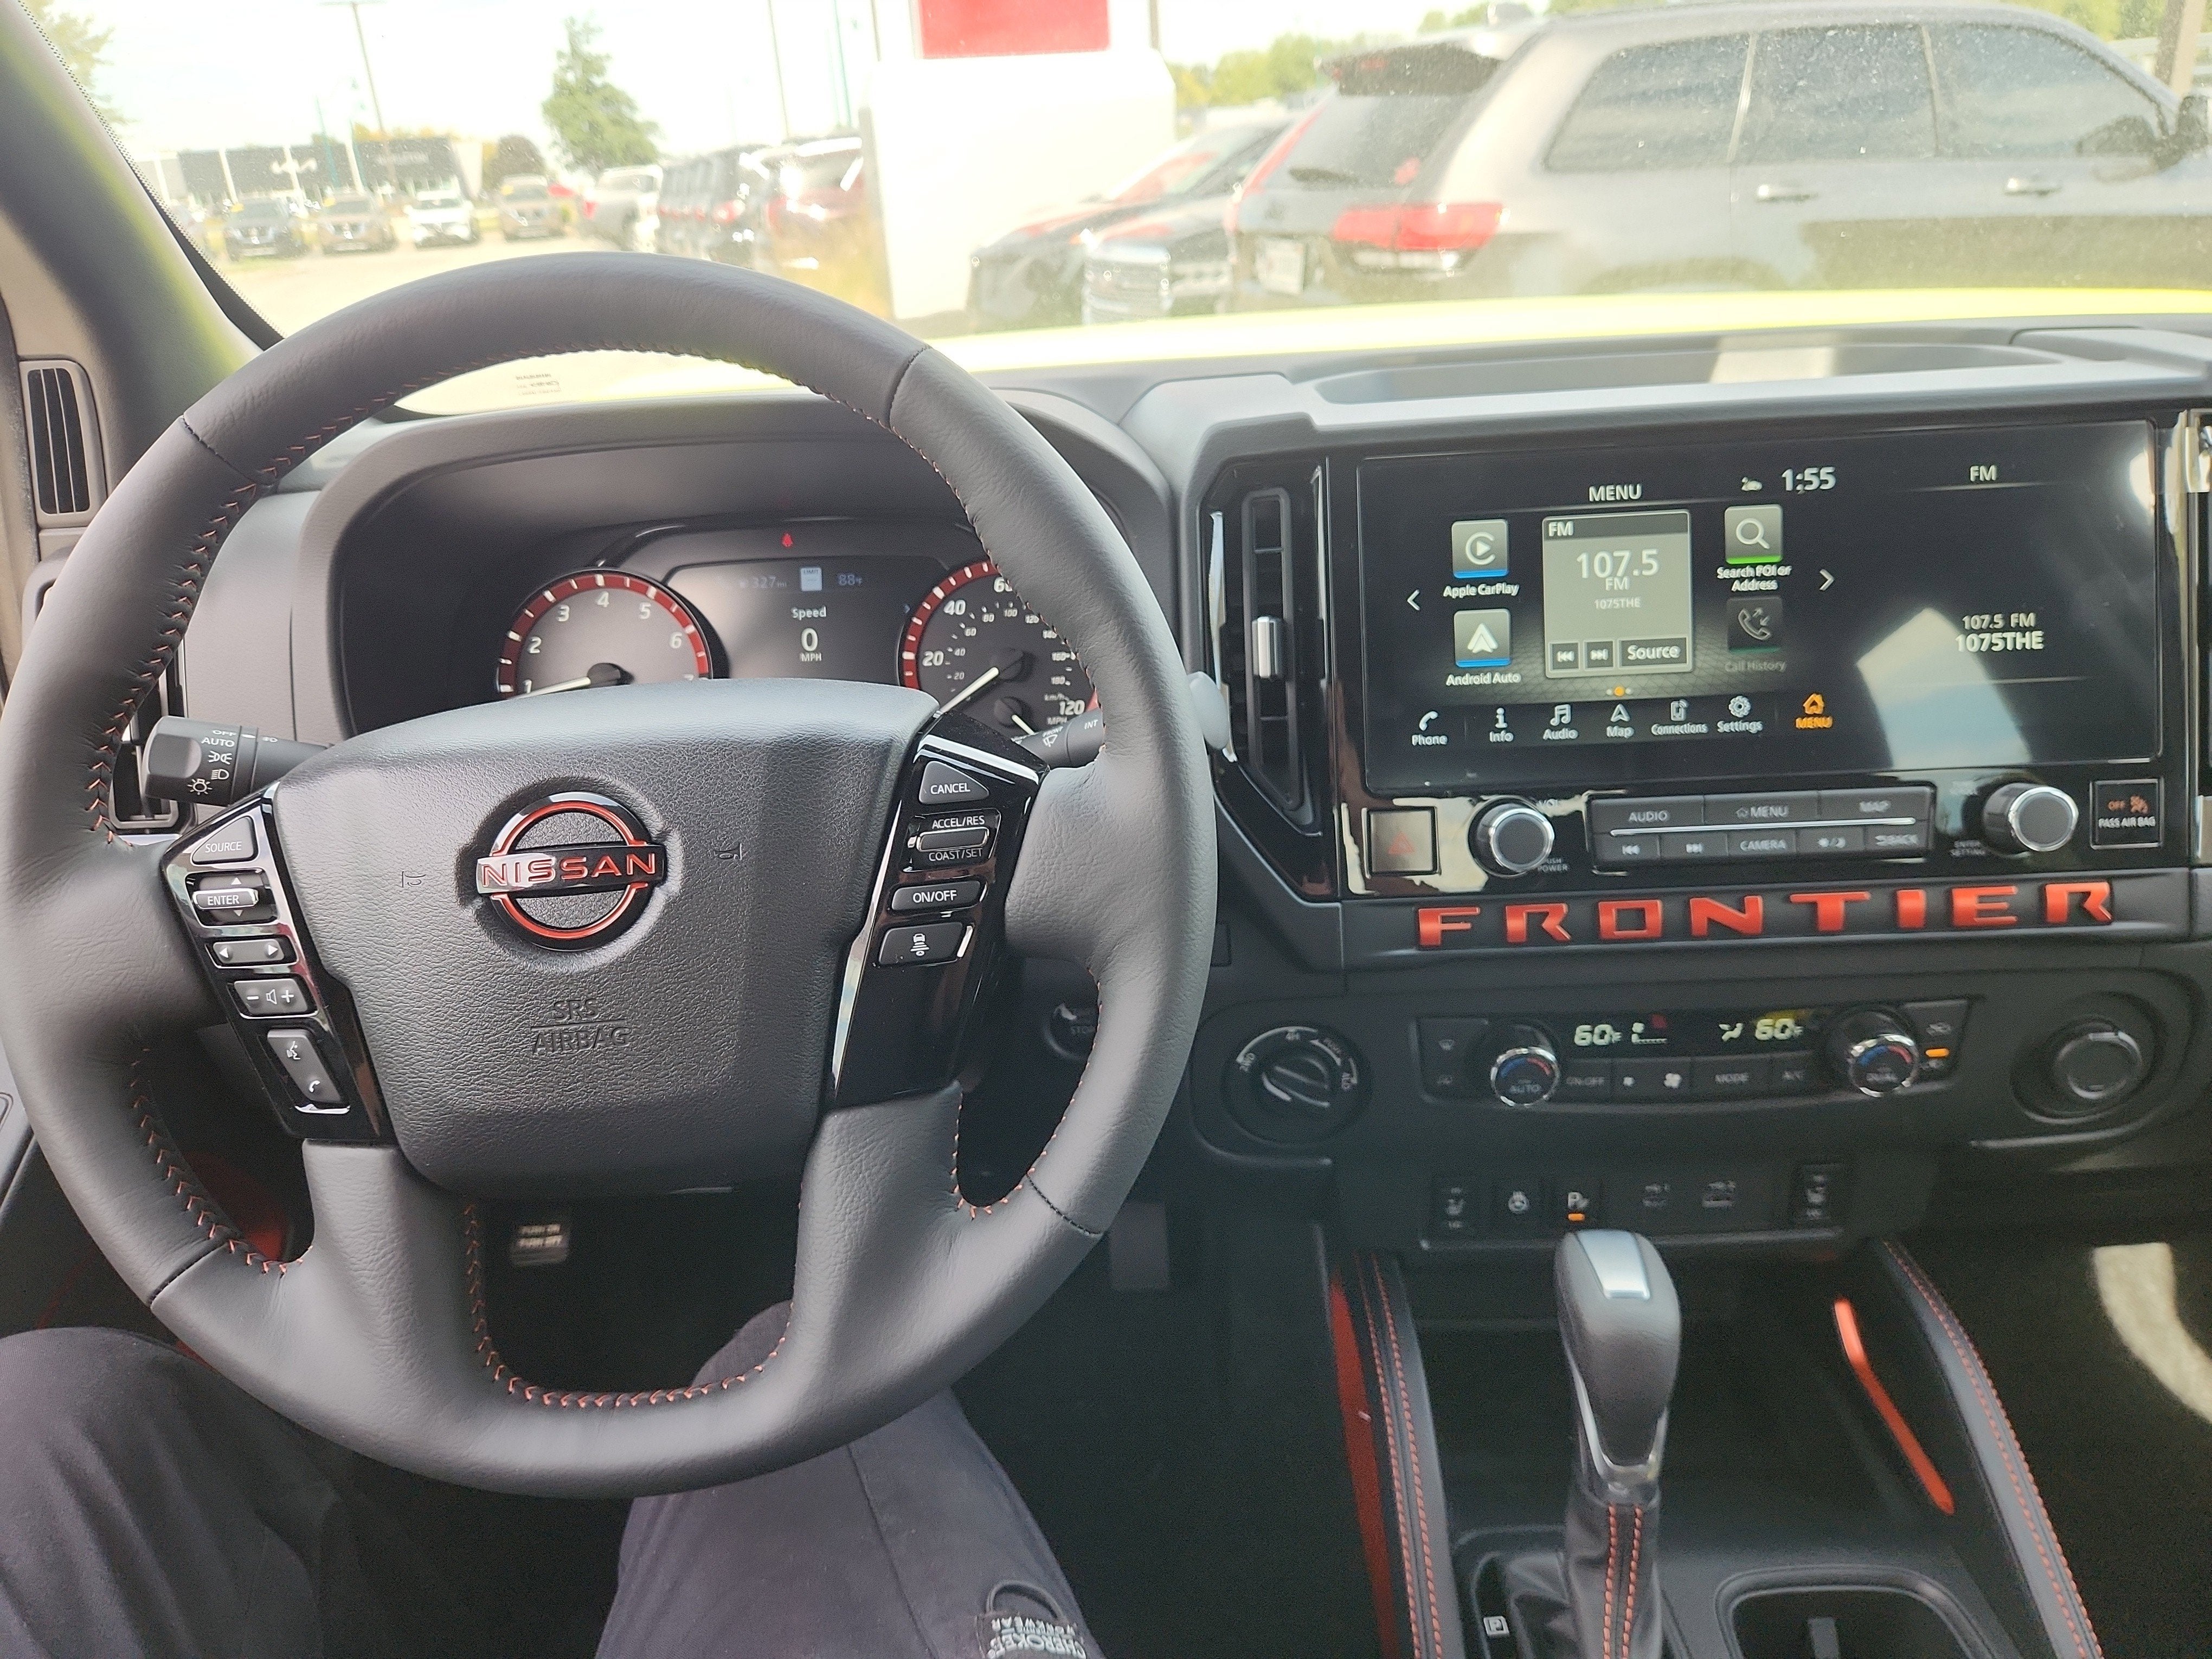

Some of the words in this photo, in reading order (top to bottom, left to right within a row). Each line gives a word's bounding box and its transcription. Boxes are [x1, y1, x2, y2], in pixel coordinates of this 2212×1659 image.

[1782, 466, 1837, 491] 1:55
[1970, 465, 1997, 482] FM
[1589, 484, 1642, 502] MENU
[1548, 521, 1573, 537] FM
[1576, 549, 1660, 578] 107.5
[1716, 565, 1755, 579] Search
[1756, 564, 1777, 577] POI
[1777, 565, 1792, 576] or
[1443, 584, 1477, 599] Apple
[1478, 582, 1519, 596] CarPlay
[1605, 577, 1628, 591] FM
[1731, 578, 1778, 591] Address
[597, 591, 609, 608] 4
[1594, 597, 1641, 610] 1075THE
[557, 606, 570, 621] 3
[639, 603, 651, 620] 5
[792, 606, 827, 621] Speed
[943, 600, 966, 615] 40
[1004, 608, 1018, 618] 100
[1963, 614, 2004, 630] 107.5
[2010, 613, 2036, 628] FM
[528, 636, 542, 654] 2
[670, 632, 683, 650] 6
[801, 628, 818, 652] 0
[1955, 630, 2044, 652] 1075THE
[799, 652, 822, 662] MPH
[922, 651, 944, 666] 20
[954, 647, 966, 657] 40
[1627, 645, 1680, 660] Source
[1725, 661, 1746, 672] Call
[1747, 660, 1786, 672] History
[954, 672, 964, 680] 20
[1446, 672, 1491, 686] Android
[1493, 672, 1521, 684] Auto
[523, 680, 532, 693] 1
[1059, 700, 1085, 715] 120
[1084, 719, 1099, 730] INT
[1651, 723, 1708, 736] Connections
[1717, 721, 1763, 734] Settings
[1796, 716, 1833, 729] MENU
[1489, 730, 1514, 742] Info
[1543, 728, 1578, 741] Audio
[1606, 725, 1635, 738] Map
[201, 736, 235, 747] AUTO
[1412, 734, 1448, 745] Phone
[930, 782, 971, 795] CANCEL
[1628, 809, 1668, 823] AUDIO
[1750, 805, 1789, 818] MENU
[931, 815, 985, 829] ACCEL/RES
[2099, 818, 2120, 828] PASS
[2121, 817, 2136, 827] AIR
[2138, 816, 2156, 827] BAG
[205, 841, 242, 853] SOURCE
[1740, 839, 1786, 851] CAMERA
[928, 847, 983, 861] COAST/SET
[481, 853, 655, 888] NISSAN
[207, 894, 240, 906] ENTER
[912, 890, 957, 903] ON/OFF
[1418, 881, 2113, 948] FRONTIER
[551, 999, 599, 1019] SRS
[531, 1026, 632, 1054] AIRBAG
